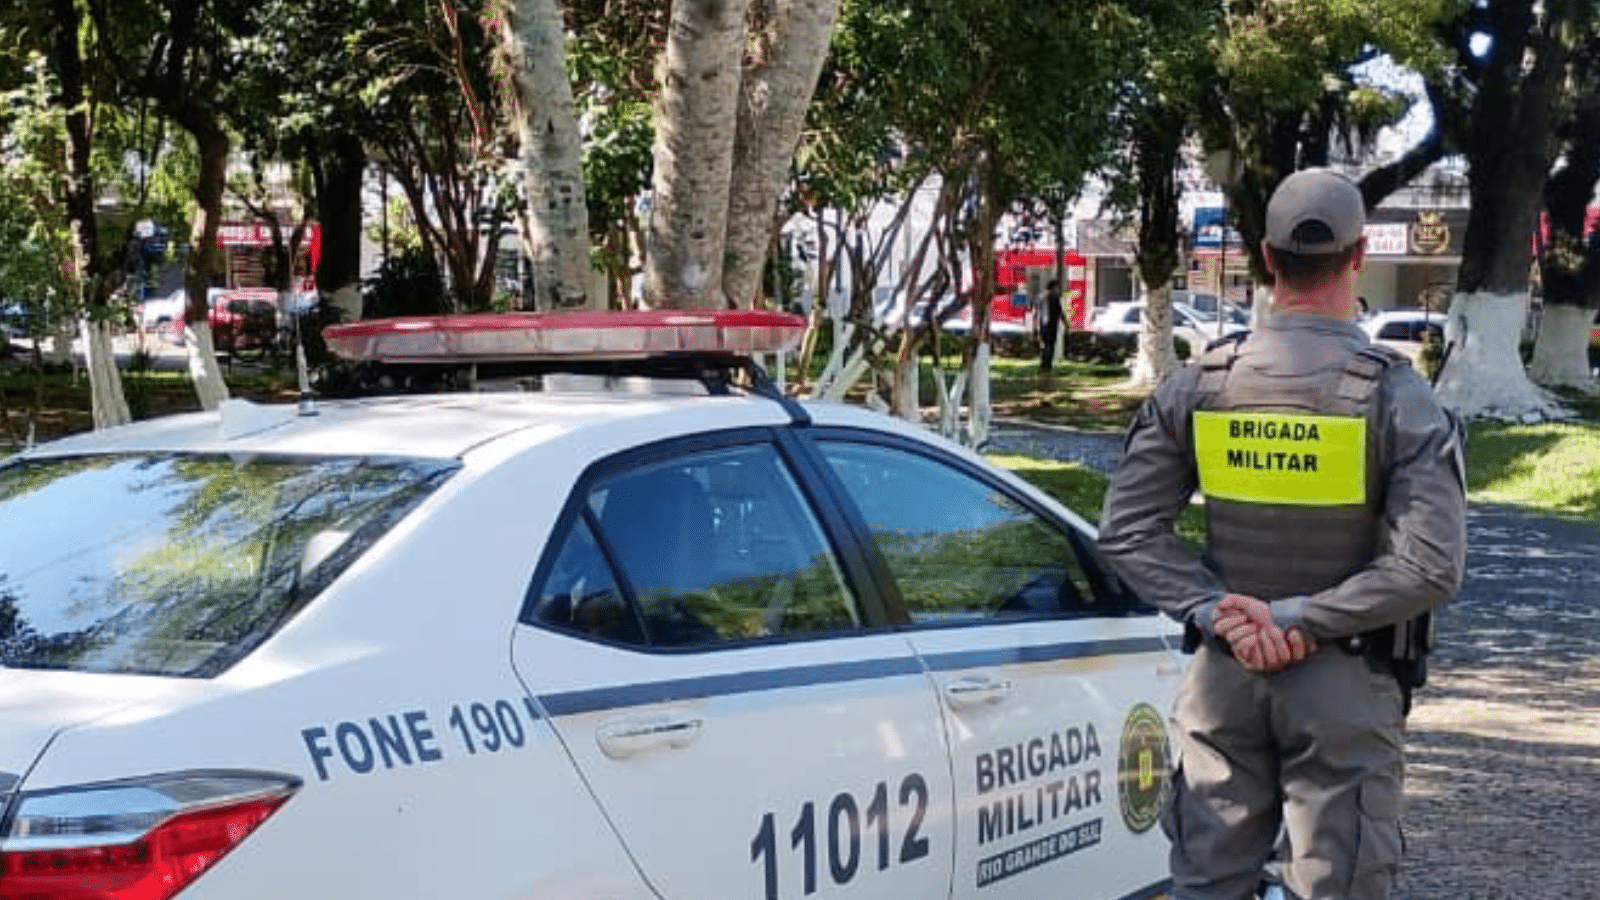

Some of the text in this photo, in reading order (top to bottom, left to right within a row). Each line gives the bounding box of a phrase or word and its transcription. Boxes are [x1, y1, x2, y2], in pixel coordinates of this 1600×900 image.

[1227, 449, 1318, 473] MILITAR
[1229, 419, 1320, 442] BRIGADA
[301, 699, 525, 781] FONE 190
[976, 722, 1101, 795] BRIGADA
[751, 773, 929, 900] 11012
[978, 769, 1102, 845] MILITAR
[978, 822, 1100, 885] RIO GRANDE DO SUL
